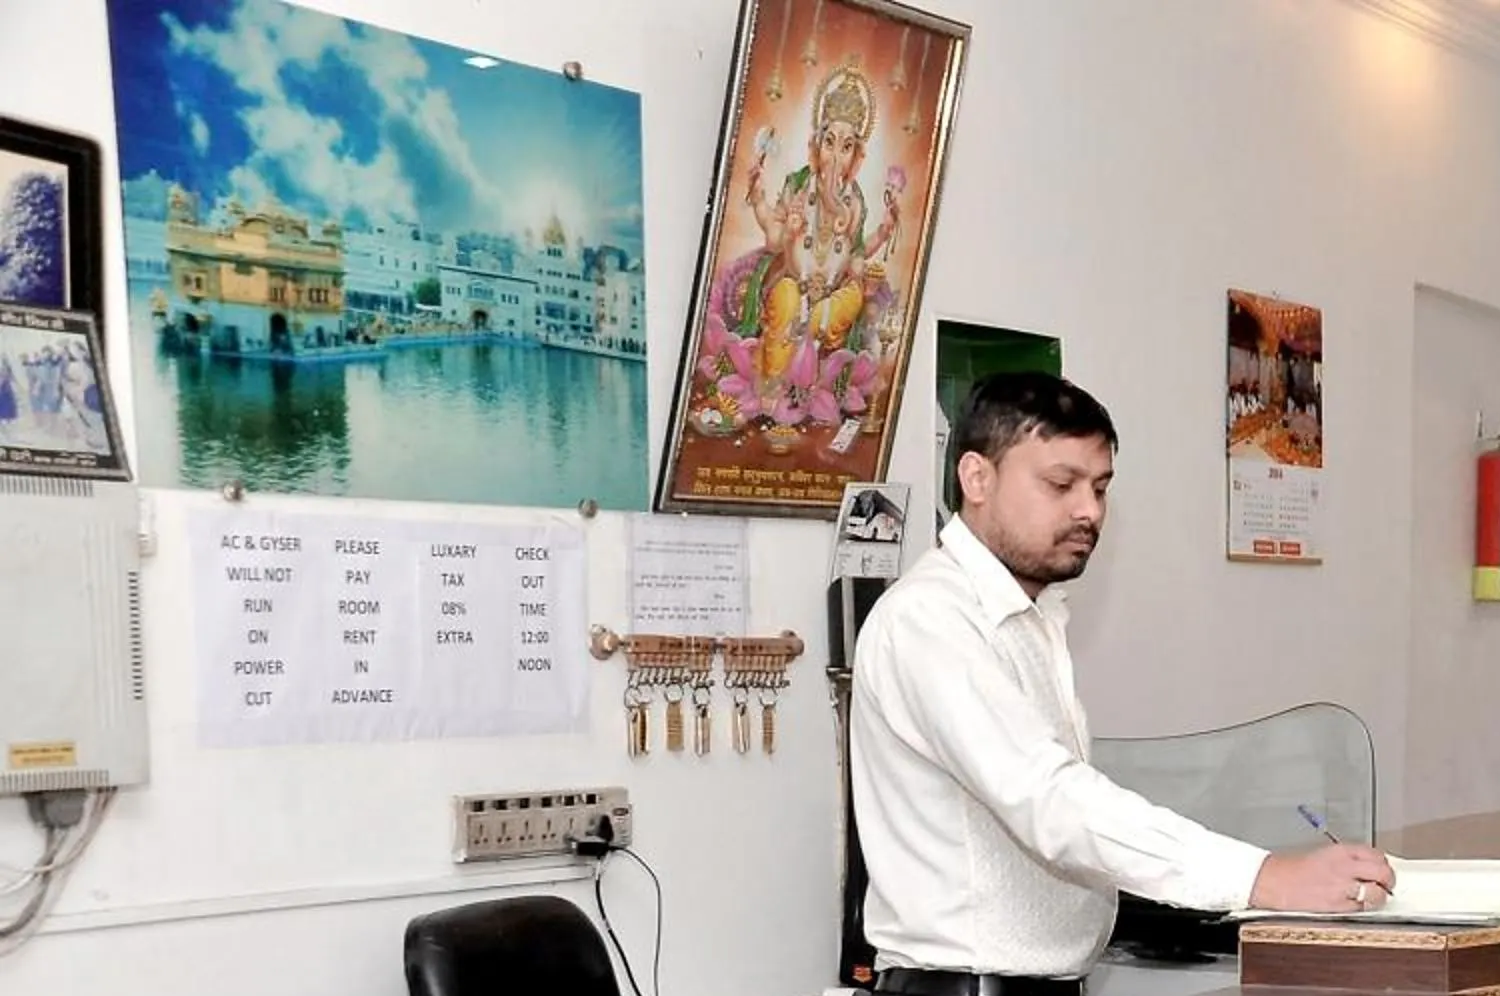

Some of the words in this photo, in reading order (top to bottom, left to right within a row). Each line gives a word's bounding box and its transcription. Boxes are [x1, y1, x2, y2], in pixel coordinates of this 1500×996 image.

[220, 534, 241, 551] AC
[243, 535, 257, 551] &
[259, 535, 302, 553] GYSER
[334, 539, 381, 556] PLEASE
[431, 543, 477, 559] LUXARY
[514, 546, 550, 561] CHECK
[225, 566, 262, 583] WILL
[263, 567, 293, 583] NOT
[345, 569, 371, 585] PAY
[440, 572, 465, 587] TAX
[520, 575, 545, 590] OUT
[243, 598, 273, 614] RUN
[337, 599, 381, 616] ROOM
[441, 600, 467, 618] 08%
[518, 602, 548, 617] TIME
[247, 629, 269, 645] ON
[342, 629, 377, 645] RENT
[436, 629, 474, 645] EXTRA
[520, 630, 550, 645] 12:00
[233, 659, 285, 676] POWER
[353, 659, 369, 674] IN
[517, 657, 552, 672] NOON
[244, 691, 273, 707] CUT
[331, 688, 395, 705] ADVANCE
